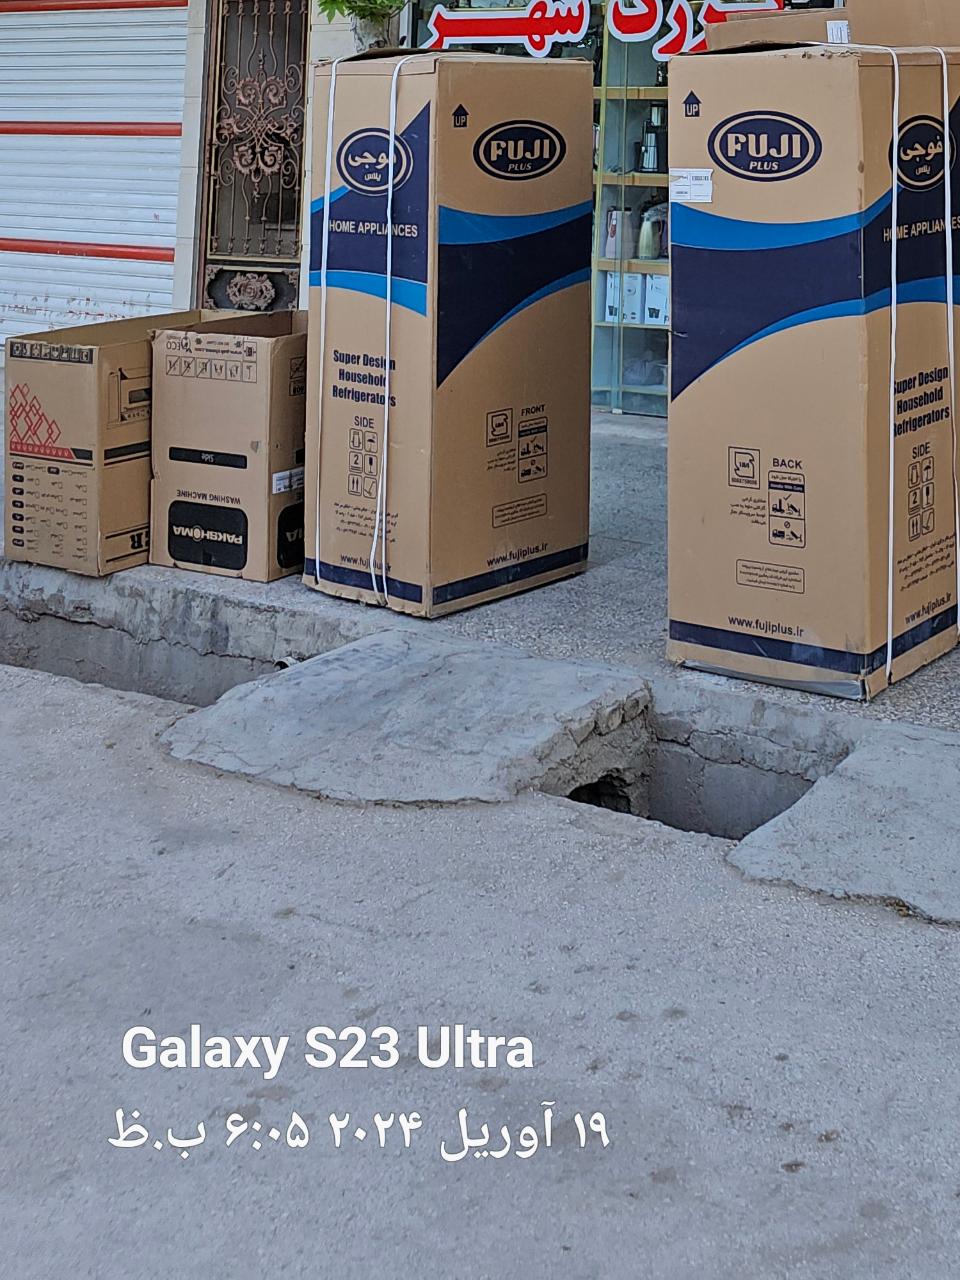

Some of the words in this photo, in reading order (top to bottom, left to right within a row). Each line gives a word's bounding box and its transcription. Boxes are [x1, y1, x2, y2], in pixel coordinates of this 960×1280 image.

[687, 104, 699, 116] UP
[455, 116, 466, 127] UP
[489, 138, 551, 162] FUJI
[727, 133, 802, 158] FUJI
[900, 135, 944, 161] فوجی
[507, 161, 532, 172] PLUS
[748, 160, 779, 171] PLUS
[329, 220, 356, 233] HOME
[333, 349, 360, 365] Super
[918, 366, 949, 387] Design
[332, 385, 396, 407] Refrigeratos
[896, 386, 944, 415] Household
[521, 405, 546, 417] FRONT
[354, 416, 375, 429] SIDE
[912, 442, 931, 459] SIDE
[772, 457, 803, 470] BACK
[176, 489, 208, 501] MACHINE
[209, 493, 241, 505] WASHING
[172, 525, 243, 546] PAKSHOMA
[486, 542, 548, 567] www.fujiplus.ir
[905, 592, 952, 625] www.fujiplus.ir
[728, 615, 804, 637] www.fujiplus.ir
